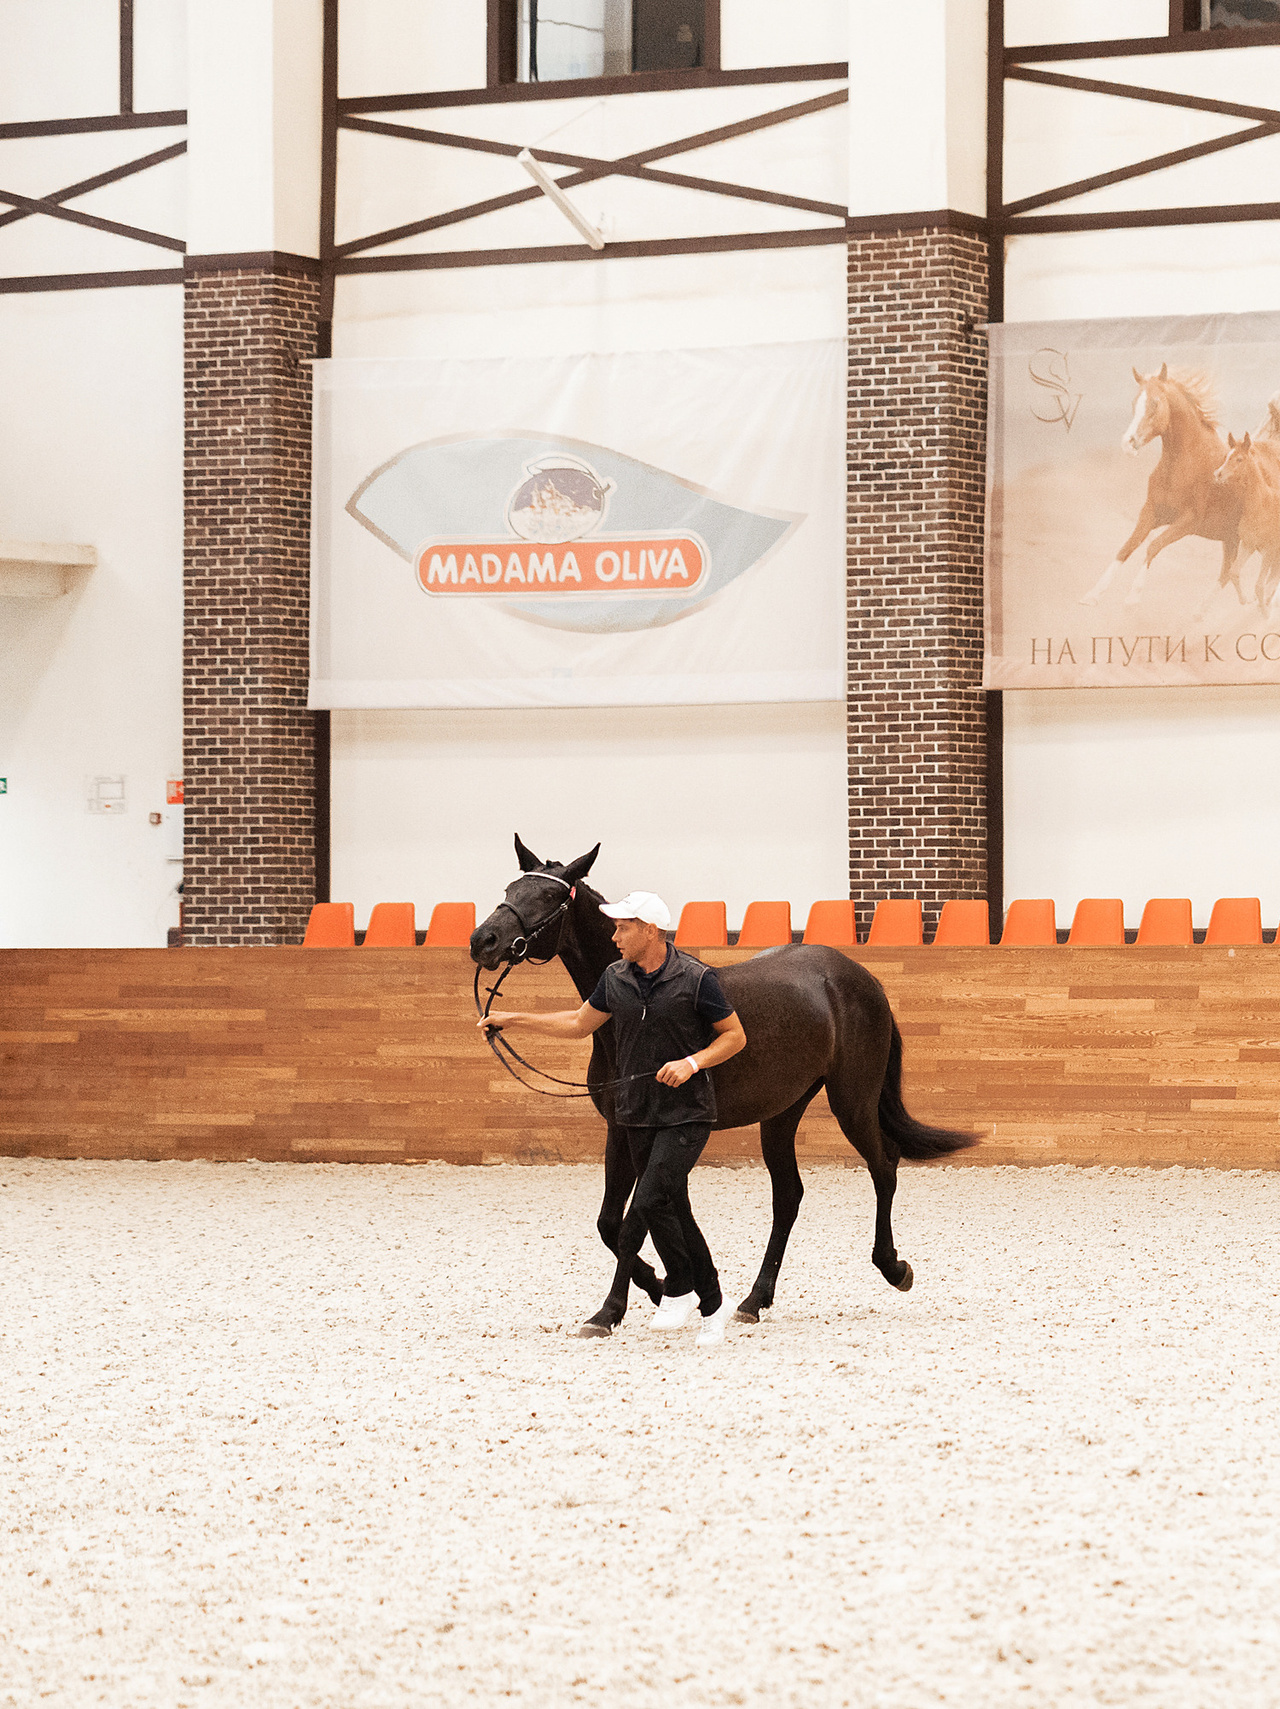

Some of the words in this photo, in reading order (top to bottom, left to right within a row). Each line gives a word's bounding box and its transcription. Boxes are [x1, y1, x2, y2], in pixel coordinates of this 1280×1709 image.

[427, 551, 581, 584] MADAMA
[595, 548, 688, 582] OLIVA
[1030, 636, 1073, 664] НА
[1091, 633, 1185, 665] ПУТИ
[1203, 633, 1223, 662] К
